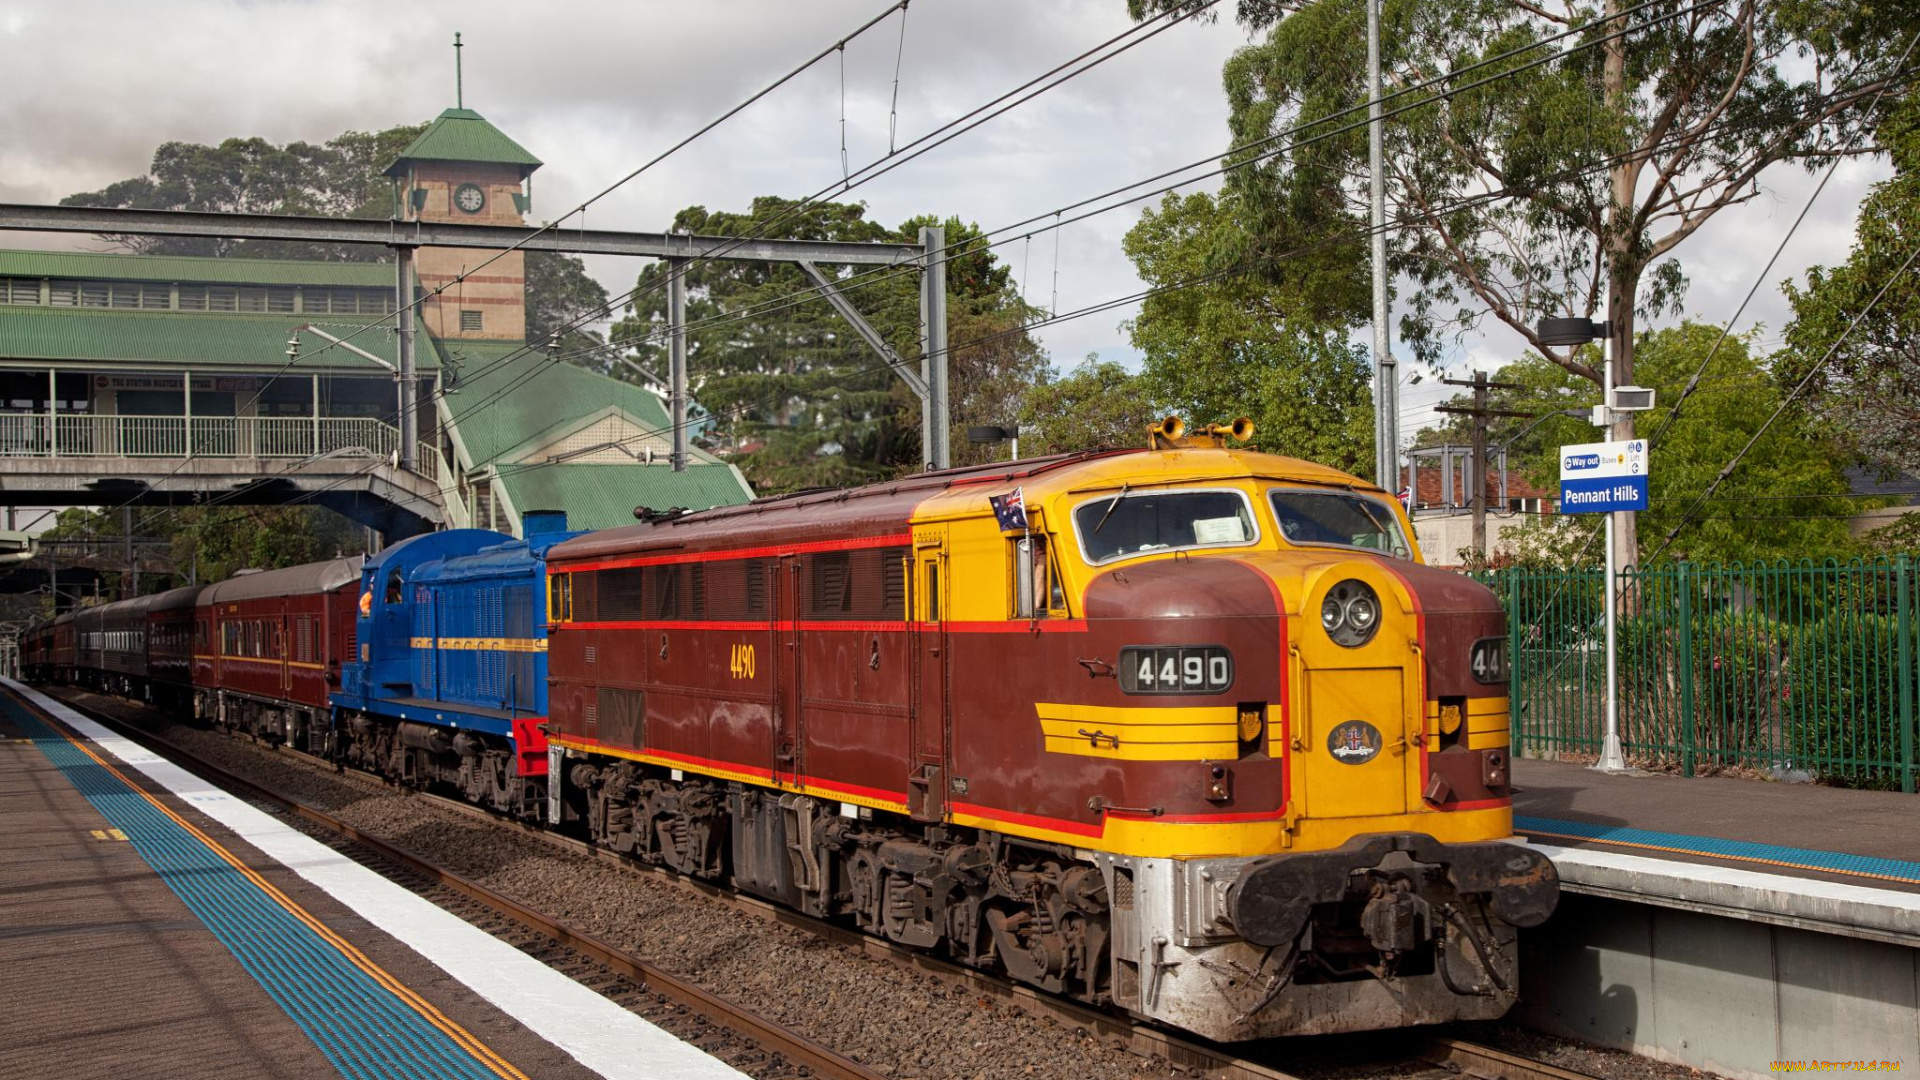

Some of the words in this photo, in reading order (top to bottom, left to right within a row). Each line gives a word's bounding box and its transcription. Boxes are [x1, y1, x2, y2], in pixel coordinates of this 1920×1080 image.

[1572, 457, 1586, 468] Way
[1587, 456, 1599, 465] out
[1565, 488, 1611, 504] Pennant
[1614, 485, 1639, 502] Hills
[731, 644, 755, 679] 4490
[1138, 657, 1228, 685] 4490
